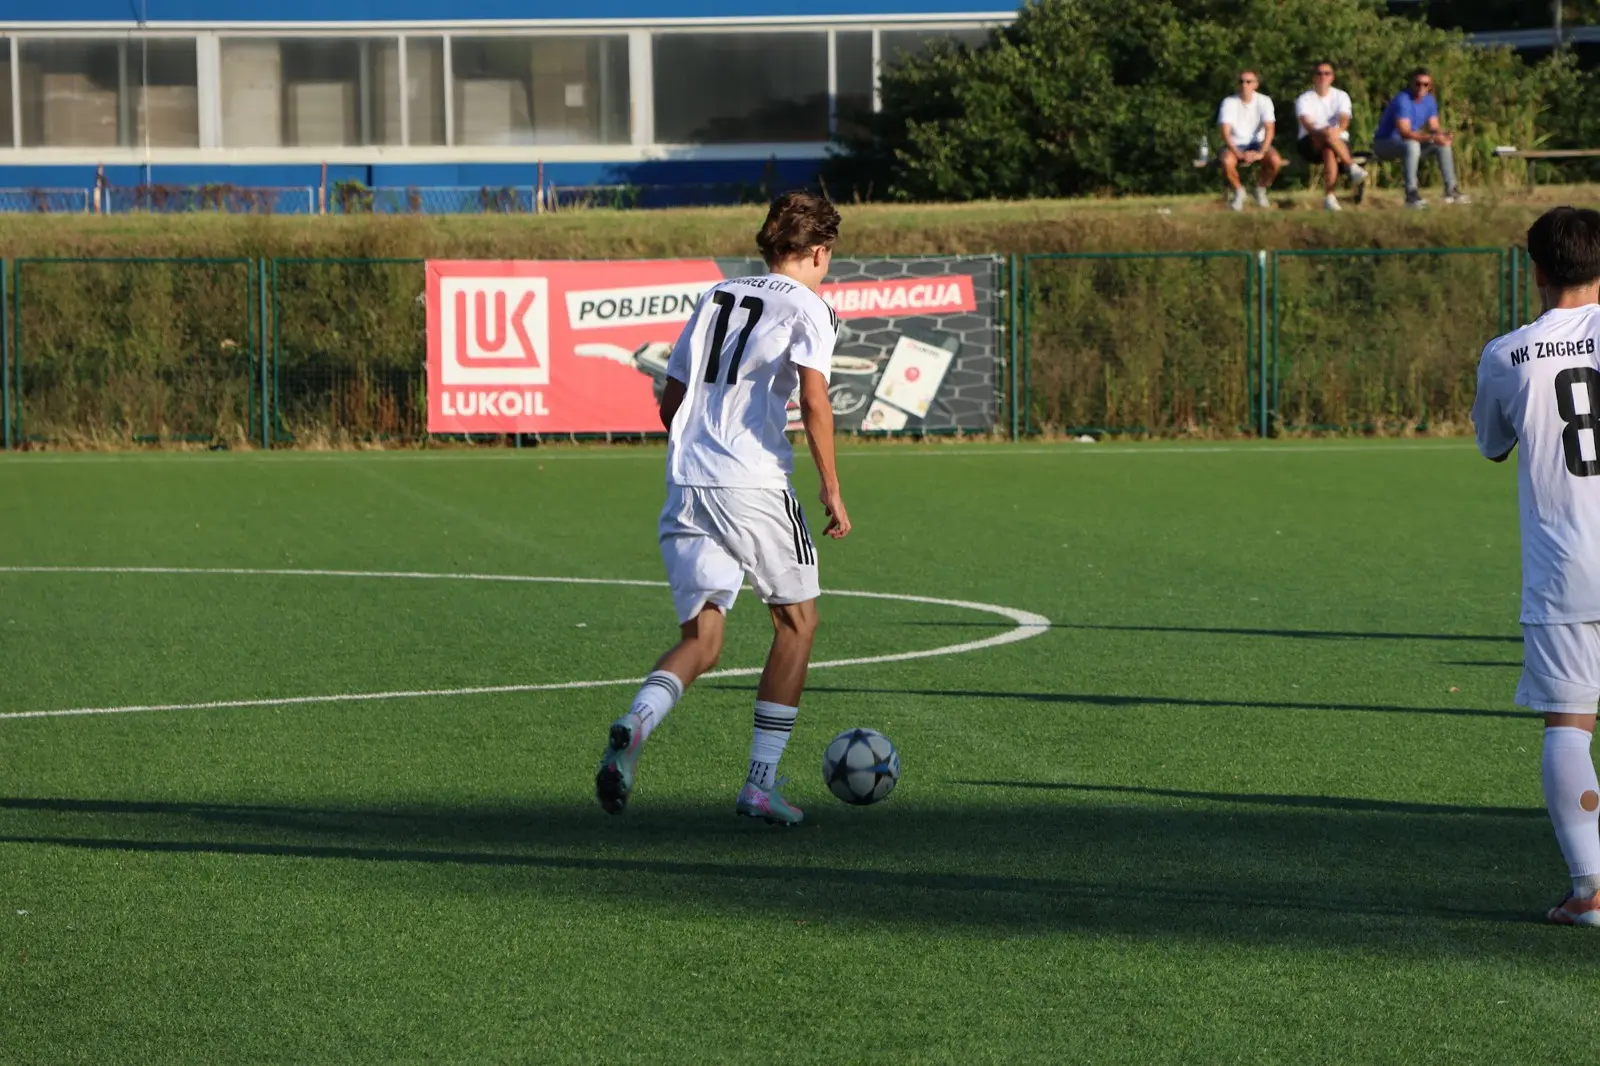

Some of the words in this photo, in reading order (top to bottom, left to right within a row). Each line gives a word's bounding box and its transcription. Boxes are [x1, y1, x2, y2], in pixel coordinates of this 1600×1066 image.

[769, 280, 797, 294] CITY
[1510, 345, 1530, 367] NK
[1535, 338, 1595, 359] ZAGREB
[441, 391, 549, 416] LUKOIL
[1554, 366, 1600, 478] 8
